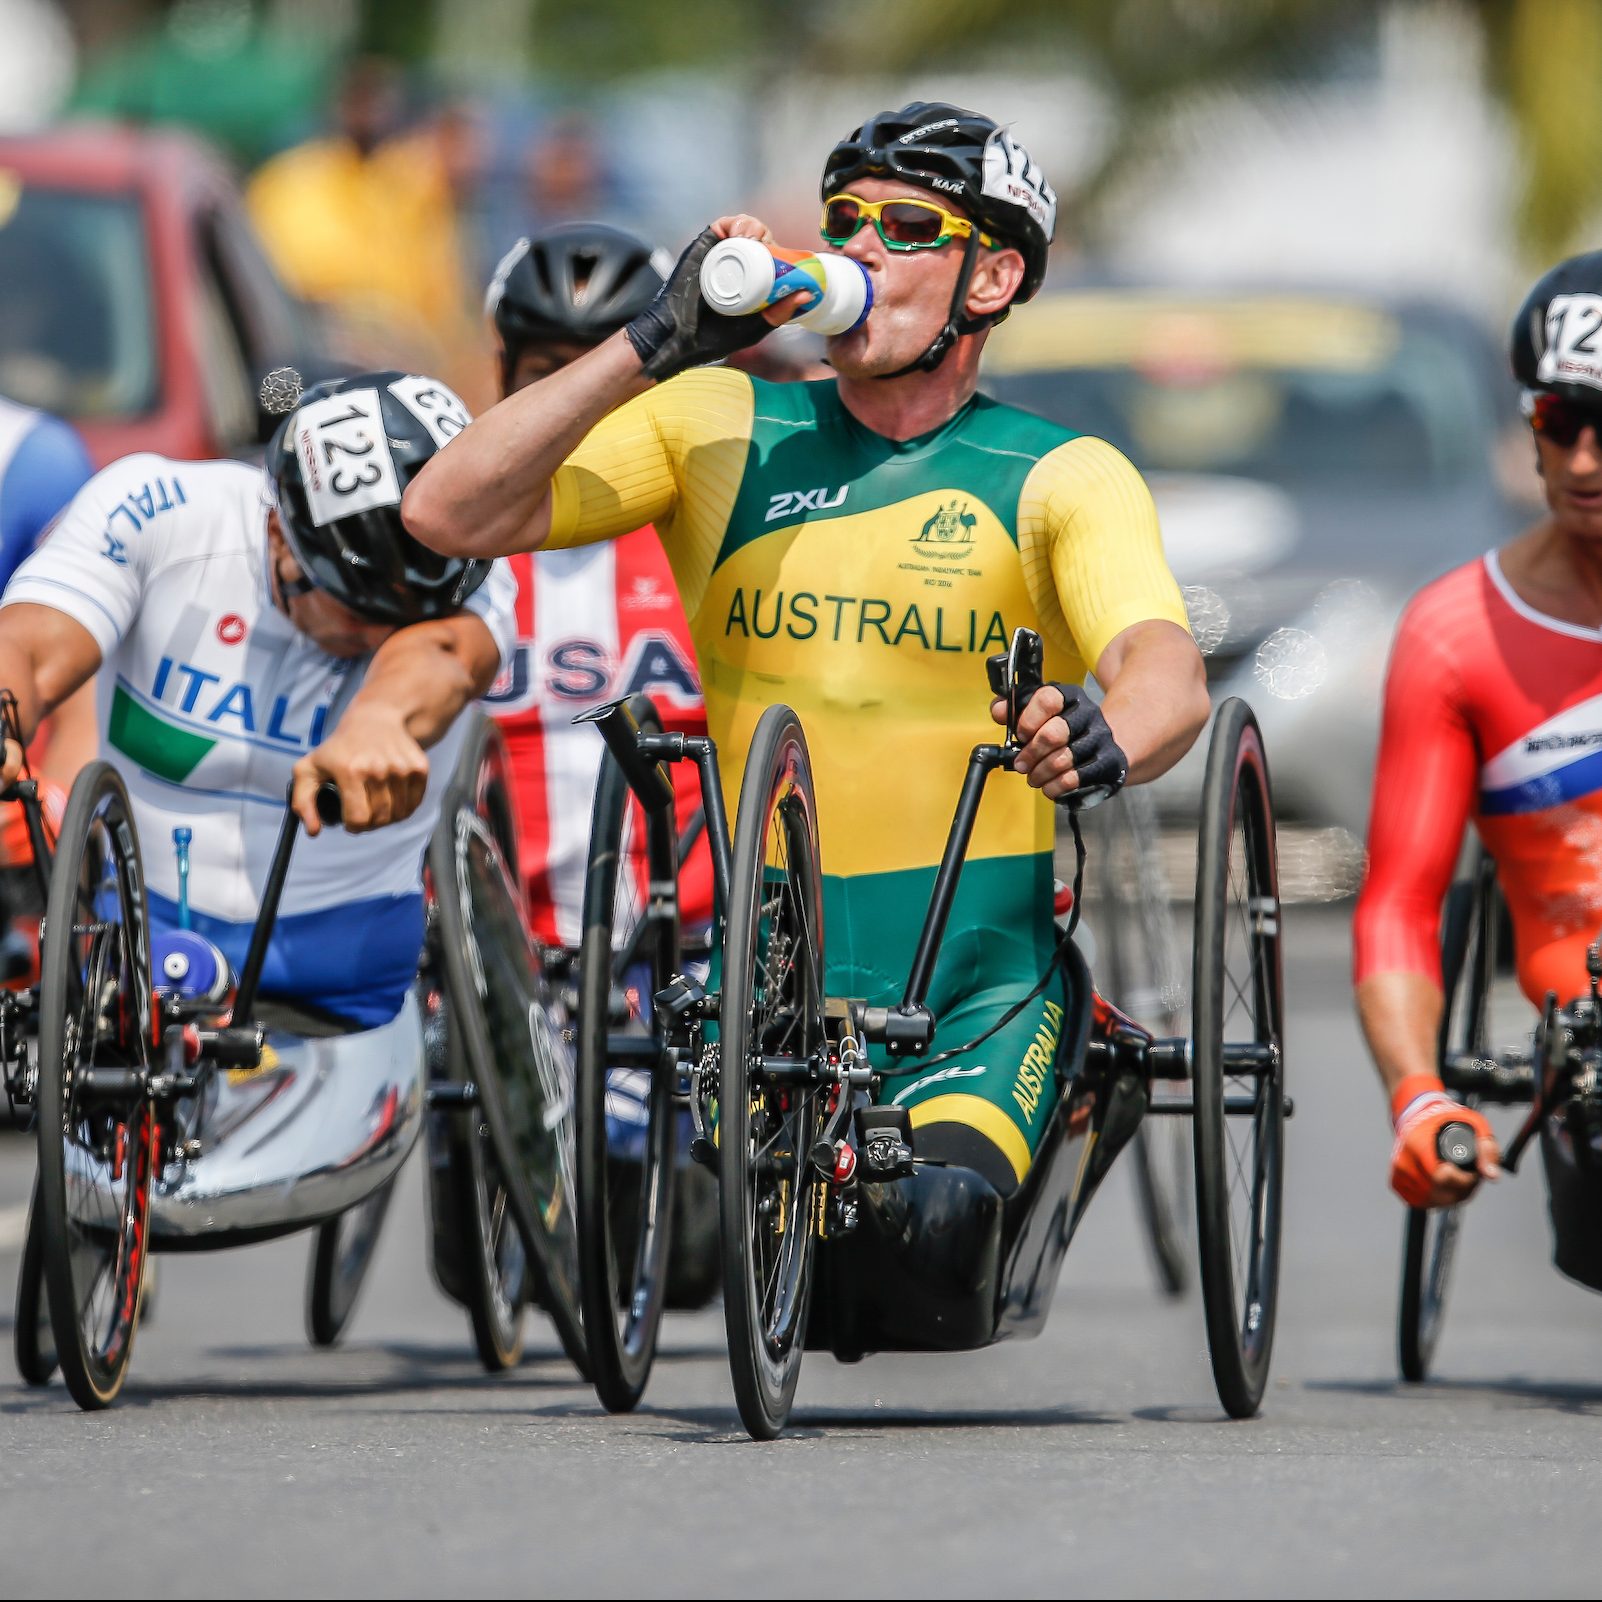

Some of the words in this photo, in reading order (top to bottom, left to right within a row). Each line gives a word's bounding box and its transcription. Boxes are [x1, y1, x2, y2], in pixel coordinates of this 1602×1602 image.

[318, 403, 383, 496] 123
[764, 484, 850, 522] 2XU
[725, 587, 1010, 652] AUSTRALIA
[151, 656, 329, 747] ITALI
[1011, 1000, 1064, 1126] AUSTRALIA
